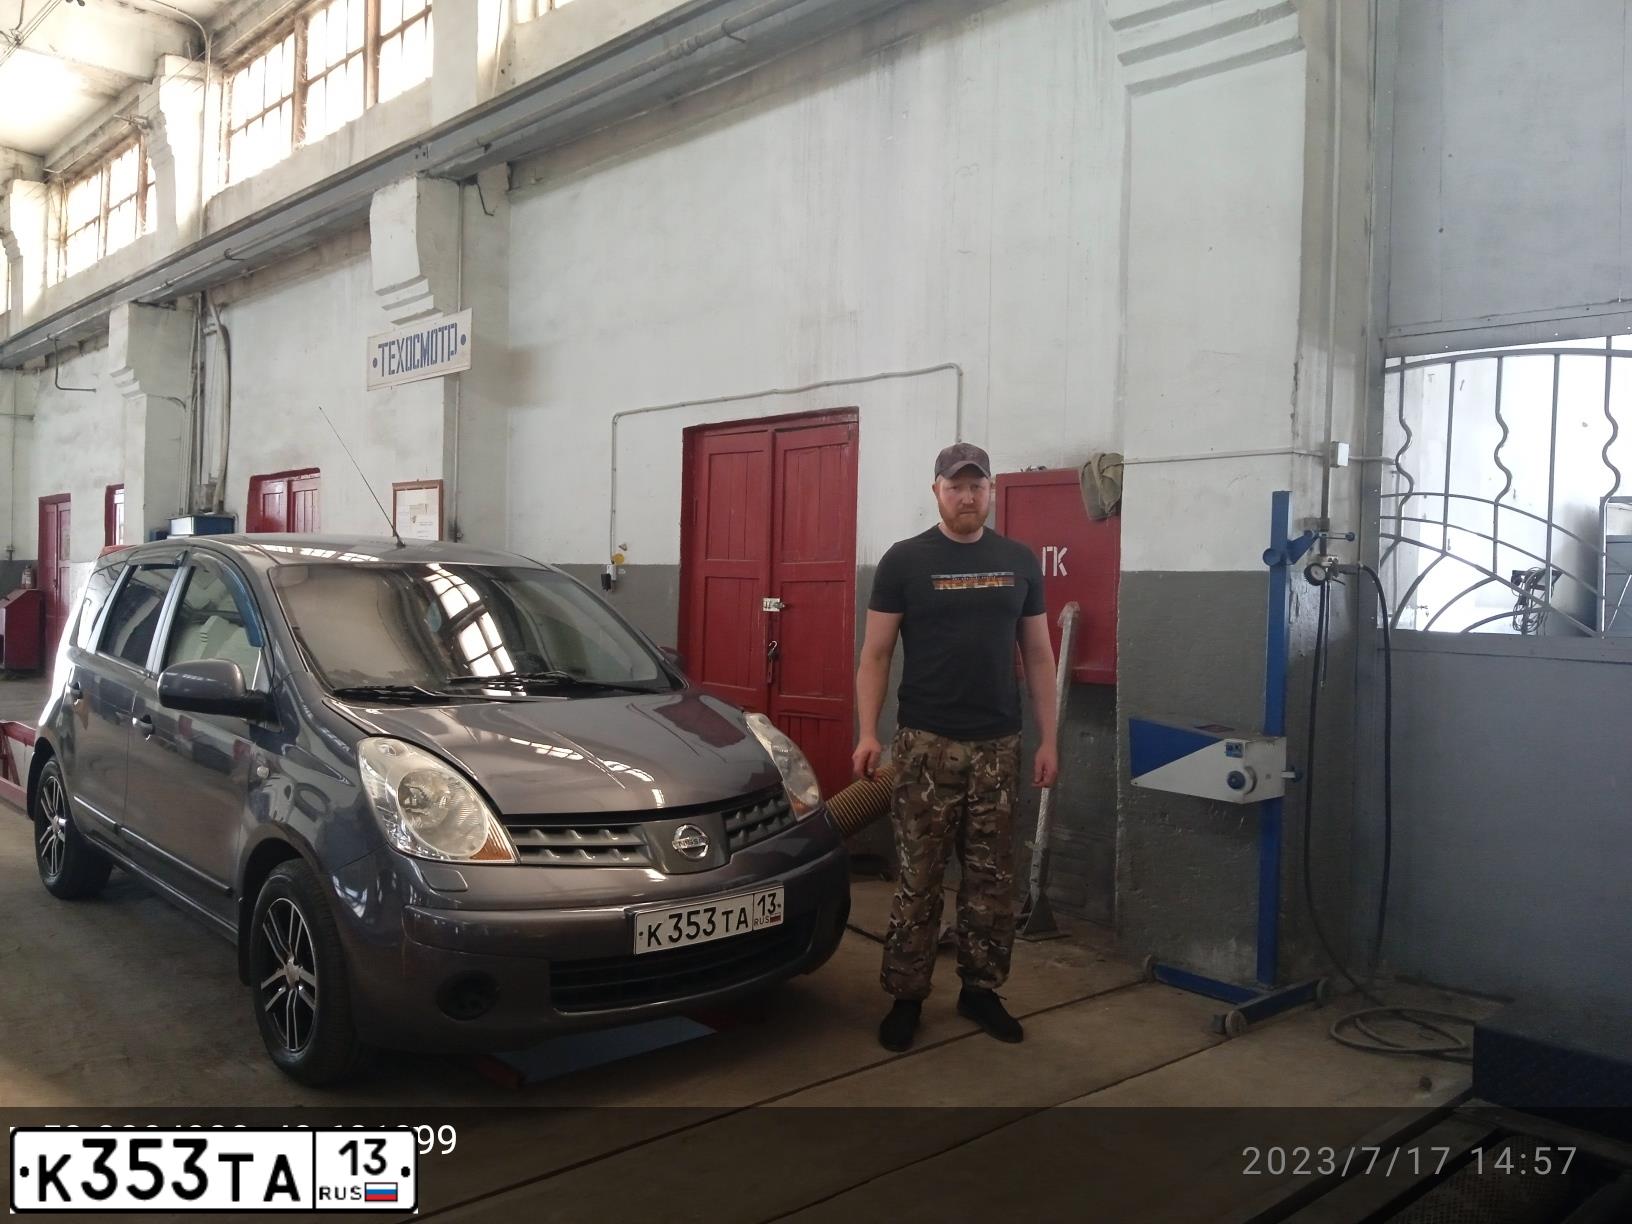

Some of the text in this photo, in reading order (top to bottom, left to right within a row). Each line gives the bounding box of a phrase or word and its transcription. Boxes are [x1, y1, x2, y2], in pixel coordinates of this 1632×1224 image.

[378, 323, 457, 377] ТЕХОСМОТР
[647, 892, 777, 947] К353ТА 13
[753, 916, 770, 926] RUS
